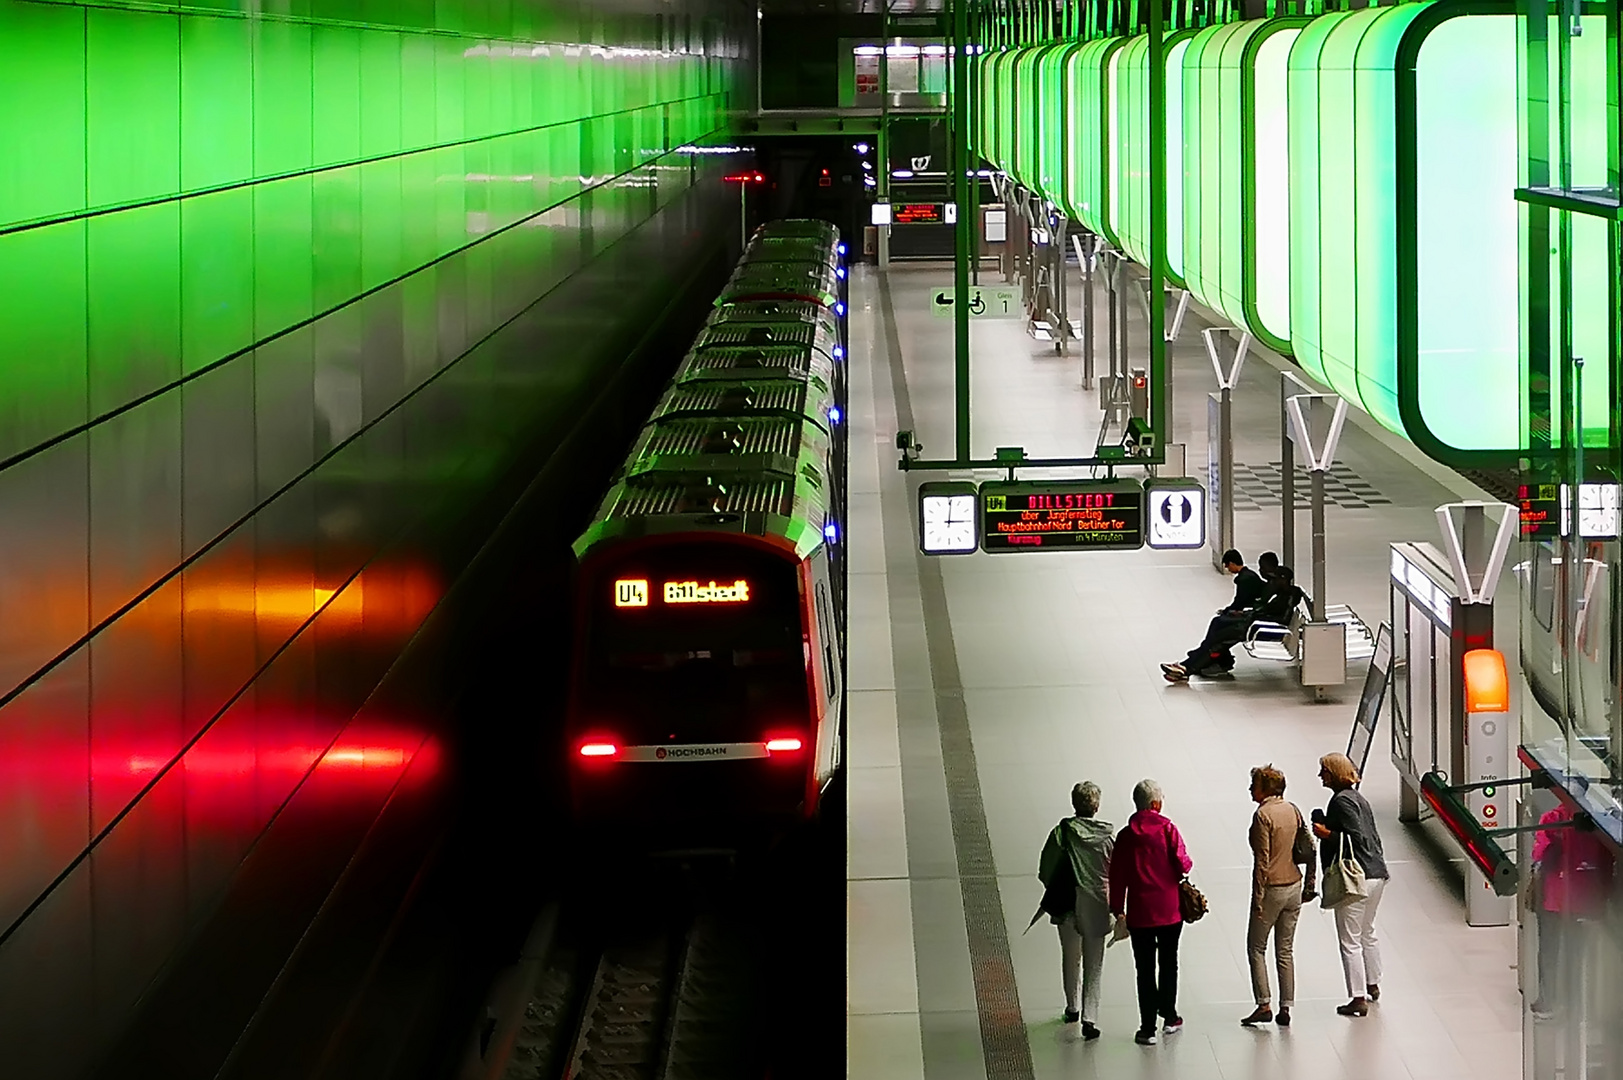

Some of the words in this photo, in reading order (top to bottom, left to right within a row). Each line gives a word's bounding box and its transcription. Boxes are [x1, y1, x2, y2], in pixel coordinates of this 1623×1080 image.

[1003, 300, 1007, 313] 1
[989, 497, 1004, 510] U4
[1028, 494, 1114, 509] BILLSTEDT
[1078, 519, 1110, 529] Berliner
[1111, 519, 1125, 529] Tor
[618, 582, 645, 604] U4
[663, 581, 749, 603] Billstedt
[668, 748, 727, 757] HOCHBAHN
